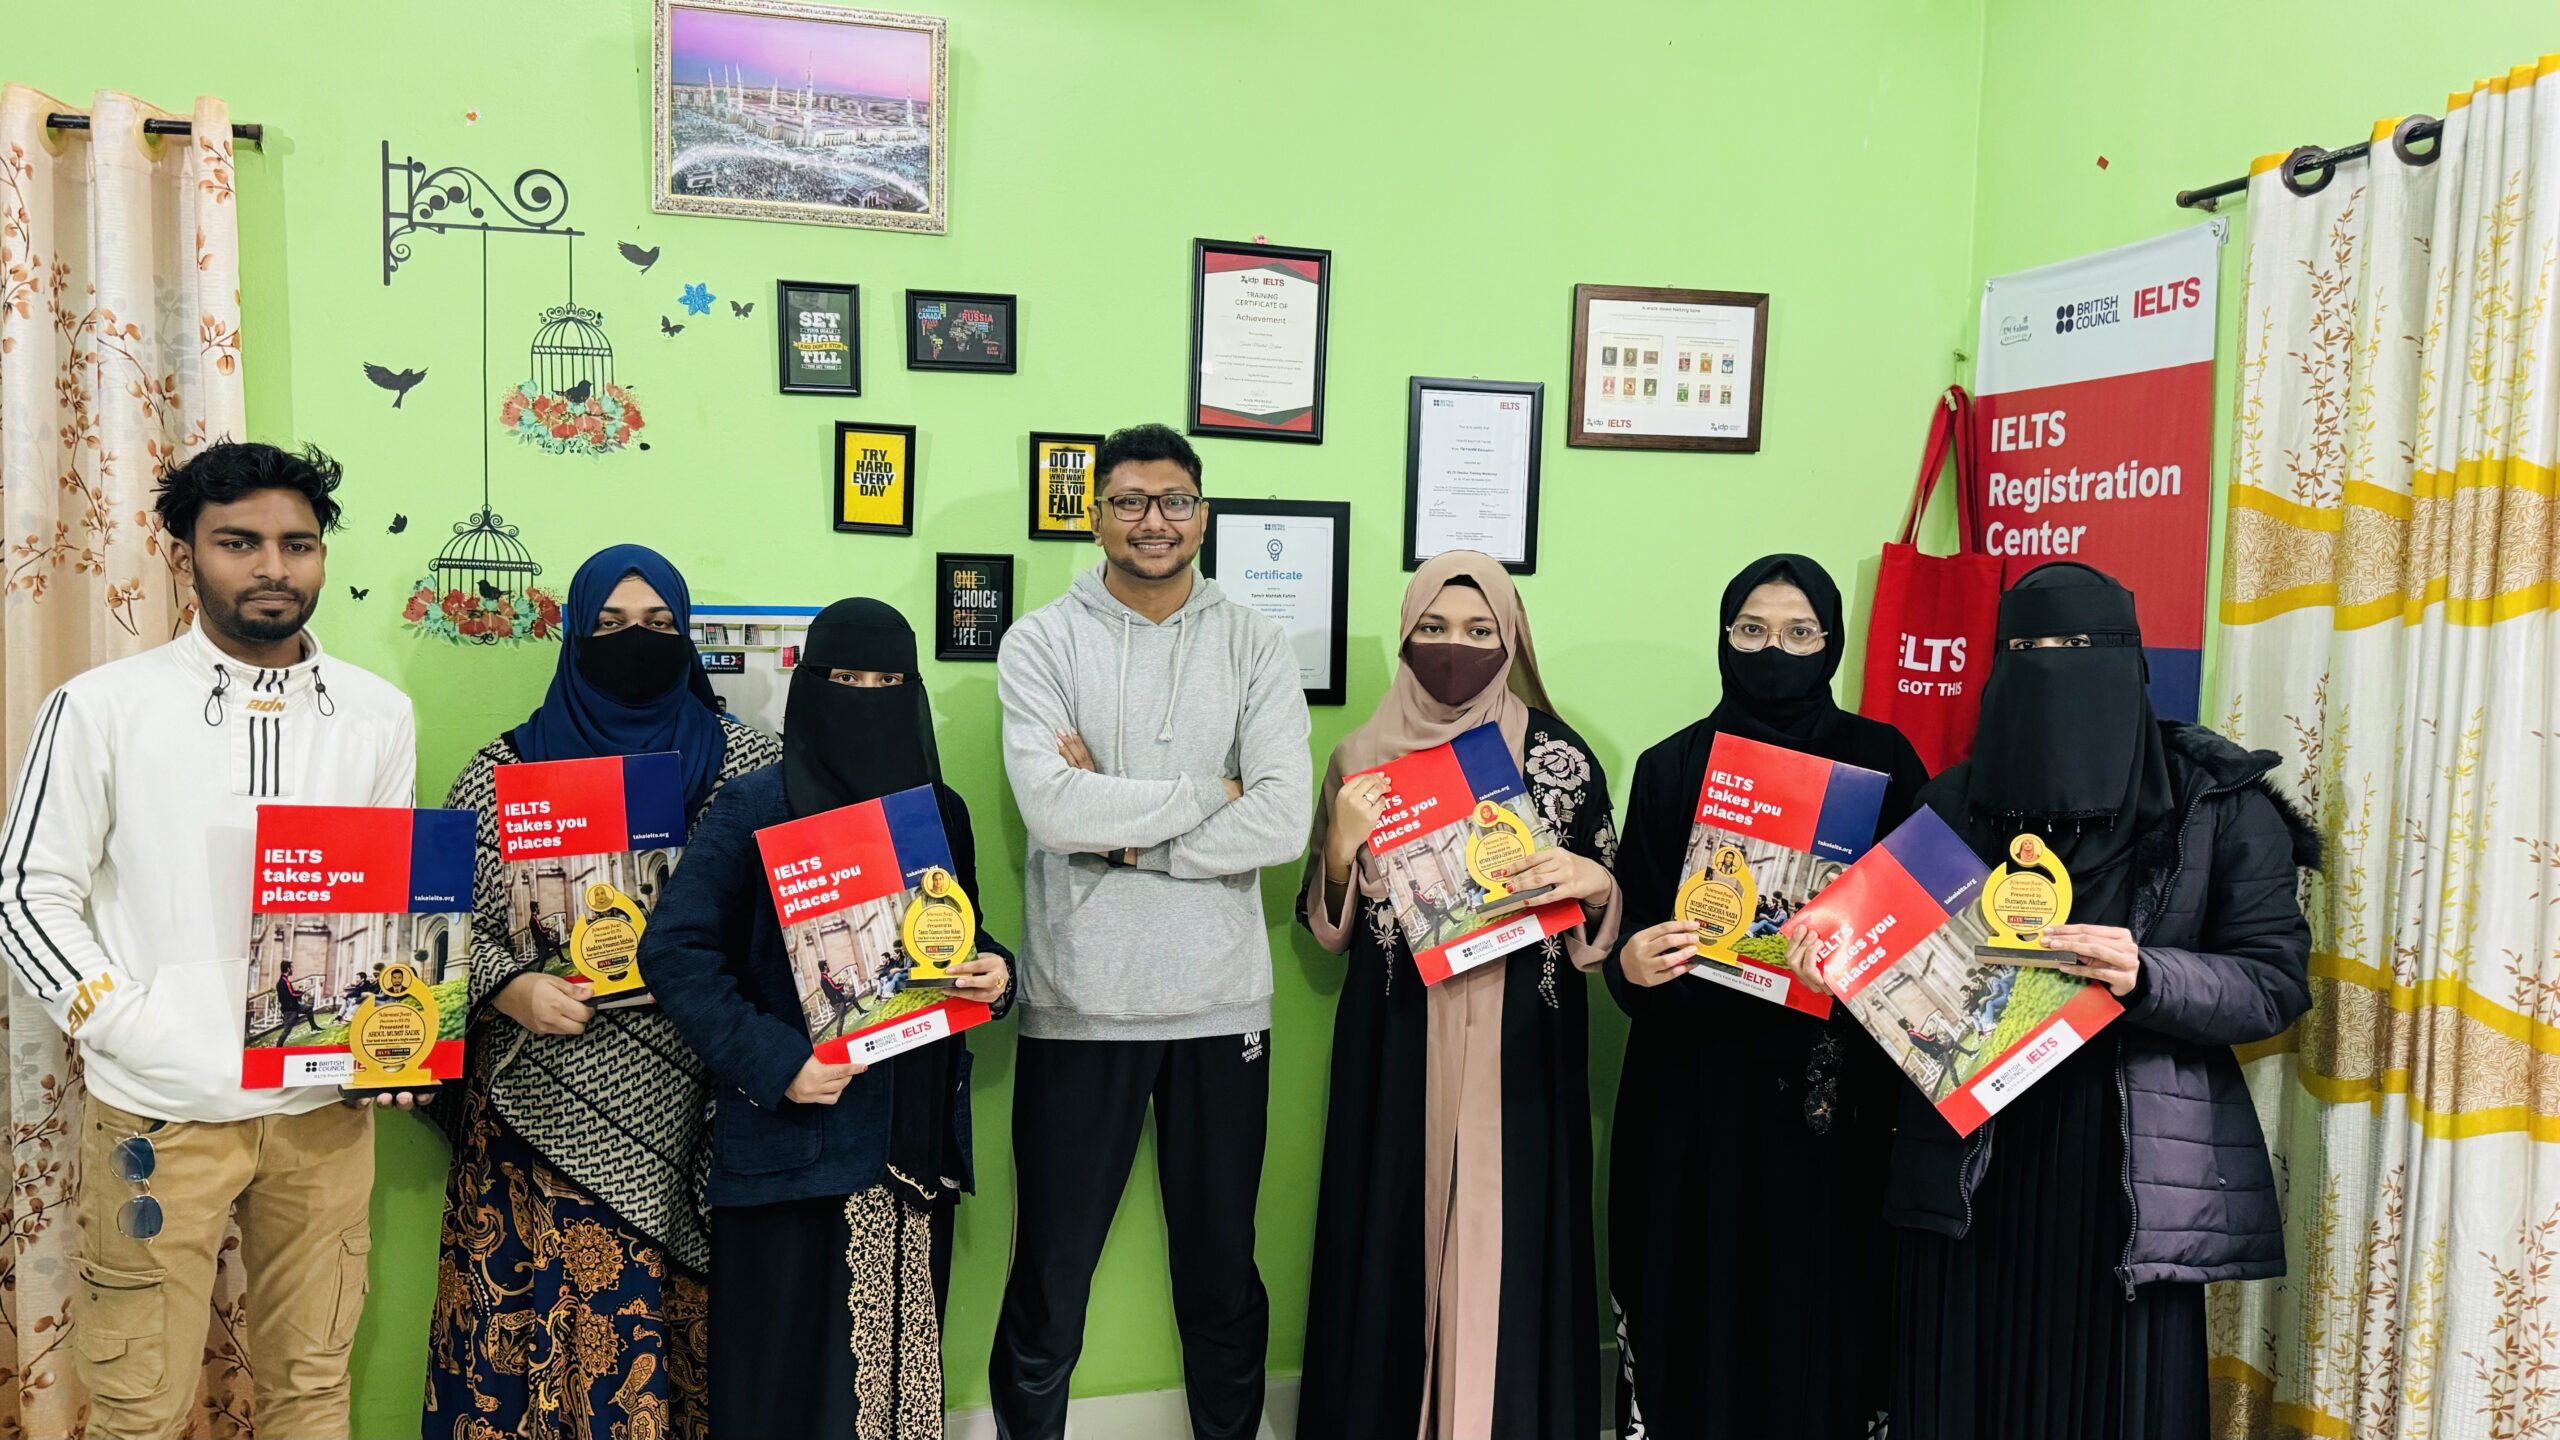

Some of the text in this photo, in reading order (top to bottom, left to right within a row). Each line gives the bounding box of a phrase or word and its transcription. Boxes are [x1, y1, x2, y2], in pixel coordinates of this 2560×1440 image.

[1248, 276, 1284, 286] idp IELTS
[1235, 299, 1277, 308] CERTIFICATE
[1247, 292, 1278, 300] TRAINING
[2133, 277, 2200, 318] IELTS
[2077, 295, 2119, 315] BRITISH
[799, 311, 840, 328] SET
[918, 312, 942, 320] CANADA
[962, 312, 993, 322] RUSSIA
[1236, 314, 1286, 324] Achievement
[2076, 309, 2120, 330] COUNCIL
[800, 334, 841, 343] HIGH
[800, 351, 842, 364] TILL
[1500, 402, 1520, 410] IELTS
[1594, 418, 1632, 428] idp IELTS
[1718, 423, 1728, 431] idp
[1991, 410, 2066, 452] IELTS
[861, 448, 887, 461] TRY
[1050, 452, 1086, 468] DO IT
[856, 460, 892, 473] HARD
[853, 472, 894, 486] EVERY
[1988, 460, 2181, 514] Registration
[860, 485, 886, 496] DAY
[1049, 484, 1085, 496] SEE YOU
[1049, 494, 1084, 514] FAIL
[1986, 520, 2086, 556] Center
[954, 570, 978, 588] ONE
[1245, 570, 1302, 580] Certificate
[953, 590, 998, 608] CHOICE
[953, 610, 977, 627] ONE
[953, 628, 976, 646] LIFE
[1898, 678, 1962, 696] GOT THIS
[1710, 770, 1754, 791] IELTS
[1479, 785, 1509, 800] takeielts.org
[1707, 785, 1782, 817] takes you
[504, 801, 550, 816] IELTS
[1373, 810, 1408, 830] akes
[1410, 796, 1438, 817] you
[1702, 802, 1753, 826] places
[506, 818, 587, 833] takes you
[1373, 820, 1421, 848] places
[508, 835, 562, 853] places
[633, 832, 669, 840] takeielts.org
[1818, 839, 1853, 855] takeielts.org
[264, 849, 322, 864] IELTS
[774, 856, 822, 880] IELTS
[262, 868, 364, 887] takes you
[778, 864, 861, 897] takes you
[262, 887, 331, 905] places
[1944, 878, 1977, 905] takeielts.org
[784, 889, 840, 918] places
[1496, 926, 1525, 943] IELTS
[1866, 914, 1896, 944] you
[1836, 946, 1886, 992] places
[1743, 970, 1772, 988] IELTS
[902, 1021, 932, 1038] IELTS
[2026, 1037, 2058, 1064] IELTS
